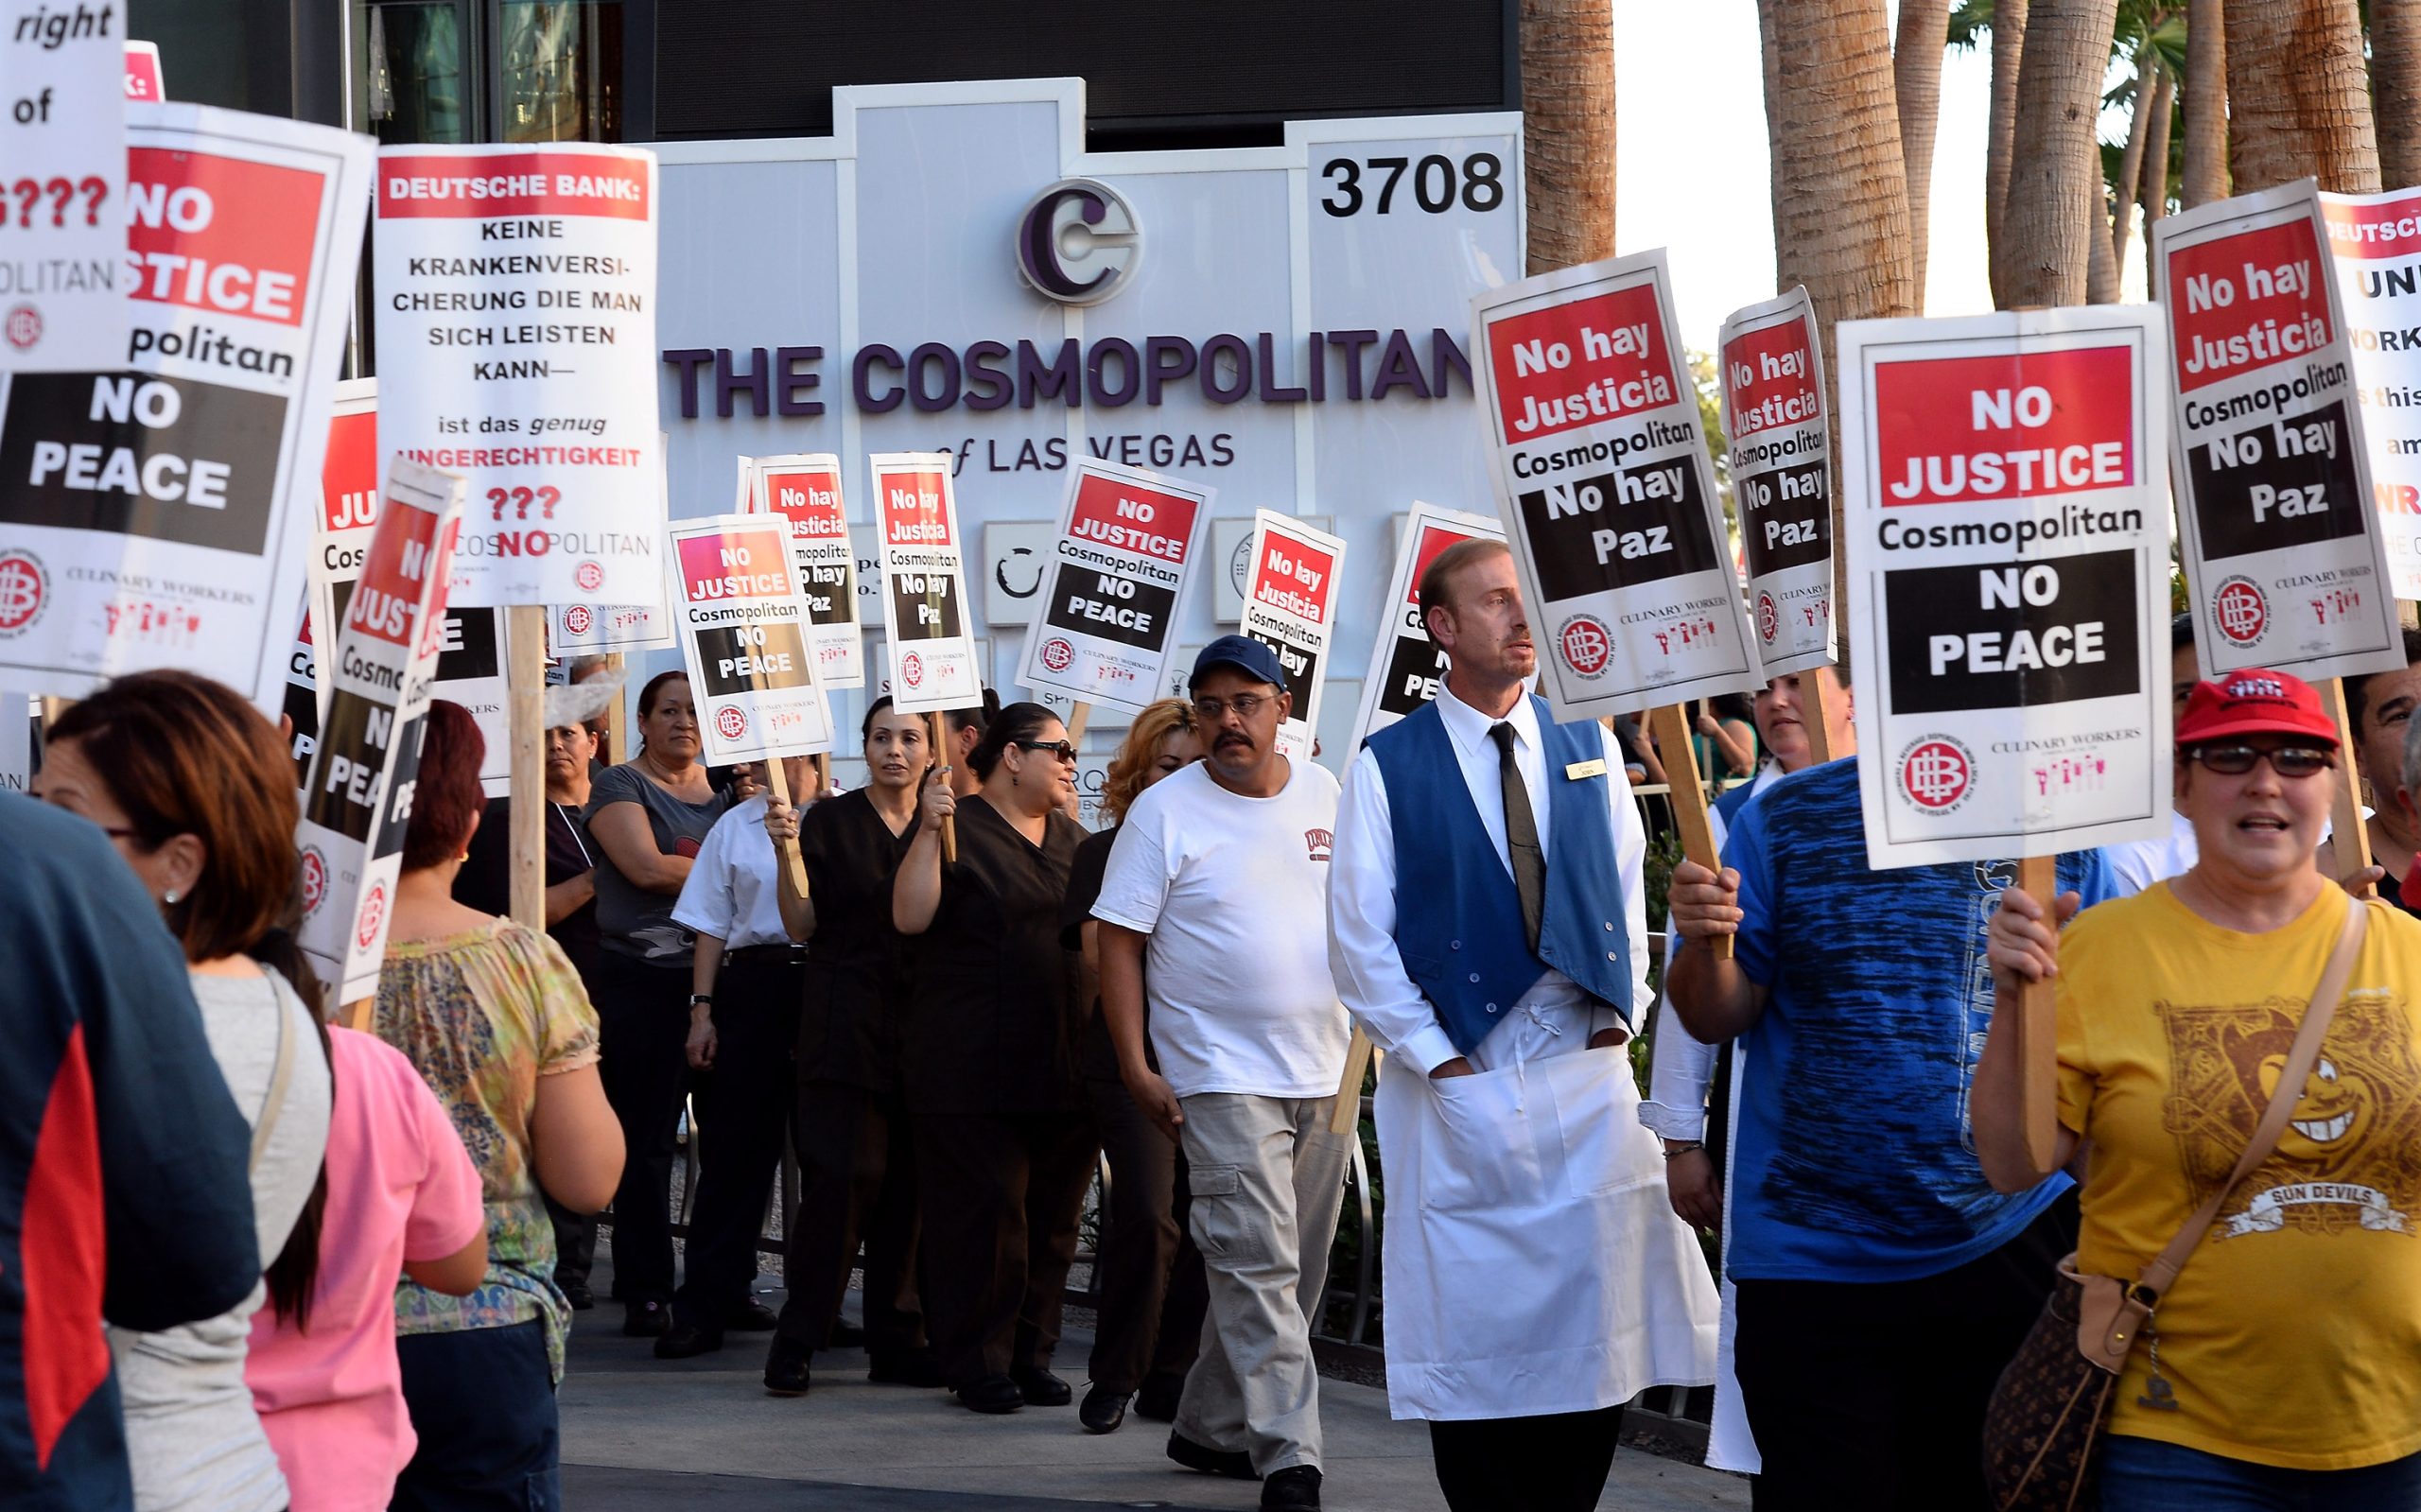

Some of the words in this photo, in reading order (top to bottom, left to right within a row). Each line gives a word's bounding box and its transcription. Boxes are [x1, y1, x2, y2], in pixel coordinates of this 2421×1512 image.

[15, 7, 113, 49] right
[14, 88, 52, 123] of
[389, 175, 547, 200] DEUTSCHE
[556, 175, 640, 201] BANK:
[1321, 152, 1504, 218] 3708
[127, 182, 214, 233] NO
[481, 220, 564, 241] KEINE
[409, 255, 630, 276] KRANKENVERSI-
[2357, 266, 2421, 298] UN
[392, 290, 526, 312] CHERUNG
[537, 290, 582, 308] DIE
[592, 291, 642, 313] MAN
[2186, 273, 2235, 314] No
[2243, 259, 2309, 300] hay
[129, 325, 294, 377] politan
[428, 327, 493, 346] SICH
[503, 325, 616, 345] LEISTEN
[1513, 339, 1572, 378] No
[1581, 322, 1648, 363] hay
[2185, 312, 2326, 374] Justicia
[663, 345, 825, 419] THE
[852, 327, 1474, 414] COSMOPOLITAN
[1730, 362, 1753, 391] No
[1761, 347, 1805, 379] hay
[89, 376, 182, 428] NO
[1515, 370, 1670, 433] Justicia
[1733, 390, 1818, 436] Justicia
[1971, 386, 2051, 431] NO
[2186, 362, 2347, 430] Cosmopolitan
[439, 417, 470, 433] ist
[479, 416, 519, 433] das
[530, 417, 607, 436] genug
[988, 438, 1068, 472] LAS
[1089, 433, 1235, 468] VEGAS
[1513, 420, 1694, 479] Cosmopolitan
[2207, 435, 2263, 471] No
[2273, 420, 2335, 459] hay
[28, 441, 231, 510] PEACE
[1746, 480, 1771, 511] No
[1779, 468, 1822, 501] hay
[1890, 442, 2123, 499] JUSTICE
[486, 485, 561, 521] ???
[780, 488, 807, 508] No
[809, 484, 838, 511] hay
[890, 489, 915, 511] No
[1116, 498, 1155, 522] NO
[1544, 482, 1604, 521] No
[1613, 466, 1684, 506] hay
[2249, 483, 2328, 523] Paz
[792, 515, 845, 536] usticia
[890, 520, 947, 542] Justicia
[1073, 518, 1183, 559] JUSTICE
[1764, 519, 1818, 550] Paz
[1878, 505, 2142, 553] Cosmopolitan
[400, 539, 432, 581] N
[721, 547, 751, 567] NO
[1057, 540, 1178, 584] Cosmopolitan
[1268, 548, 1293, 576] No
[1593, 525, 1672, 565] Paz
[66, 568, 155, 590] CULINARY
[163, 580, 255, 605] WORKERS
[691, 572, 786, 601] JUSTICE
[812, 565, 845, 586] hay
[900, 574, 925, 595] No
[1097, 575, 1135, 600] NO
[1980, 565, 2059, 610] NO
[2275, 571, 2337, 589] CULINARY
[688, 603, 798, 625] Cosmopolitan
[917, 603, 940, 625] Paz
[1068, 597, 1152, 633] PEACE
[1258, 581, 1321, 621] Justicia
[1620, 605, 1681, 625] CULINARY
[1685, 597, 1726, 610] WORKERS
[736, 627, 766, 647] NO
[1248, 606, 1322, 648] Cosmopolitan
[719, 652, 792, 679] PEACE
[1929, 621, 2105, 676] PEACE
[1992, 735, 2066, 754] CULINARY
[2073, 727, 2141, 744] WORKERS
[2272, 1187, 2308, 1203] SUN
[2313, 1186, 2373, 1202] DEVILS
